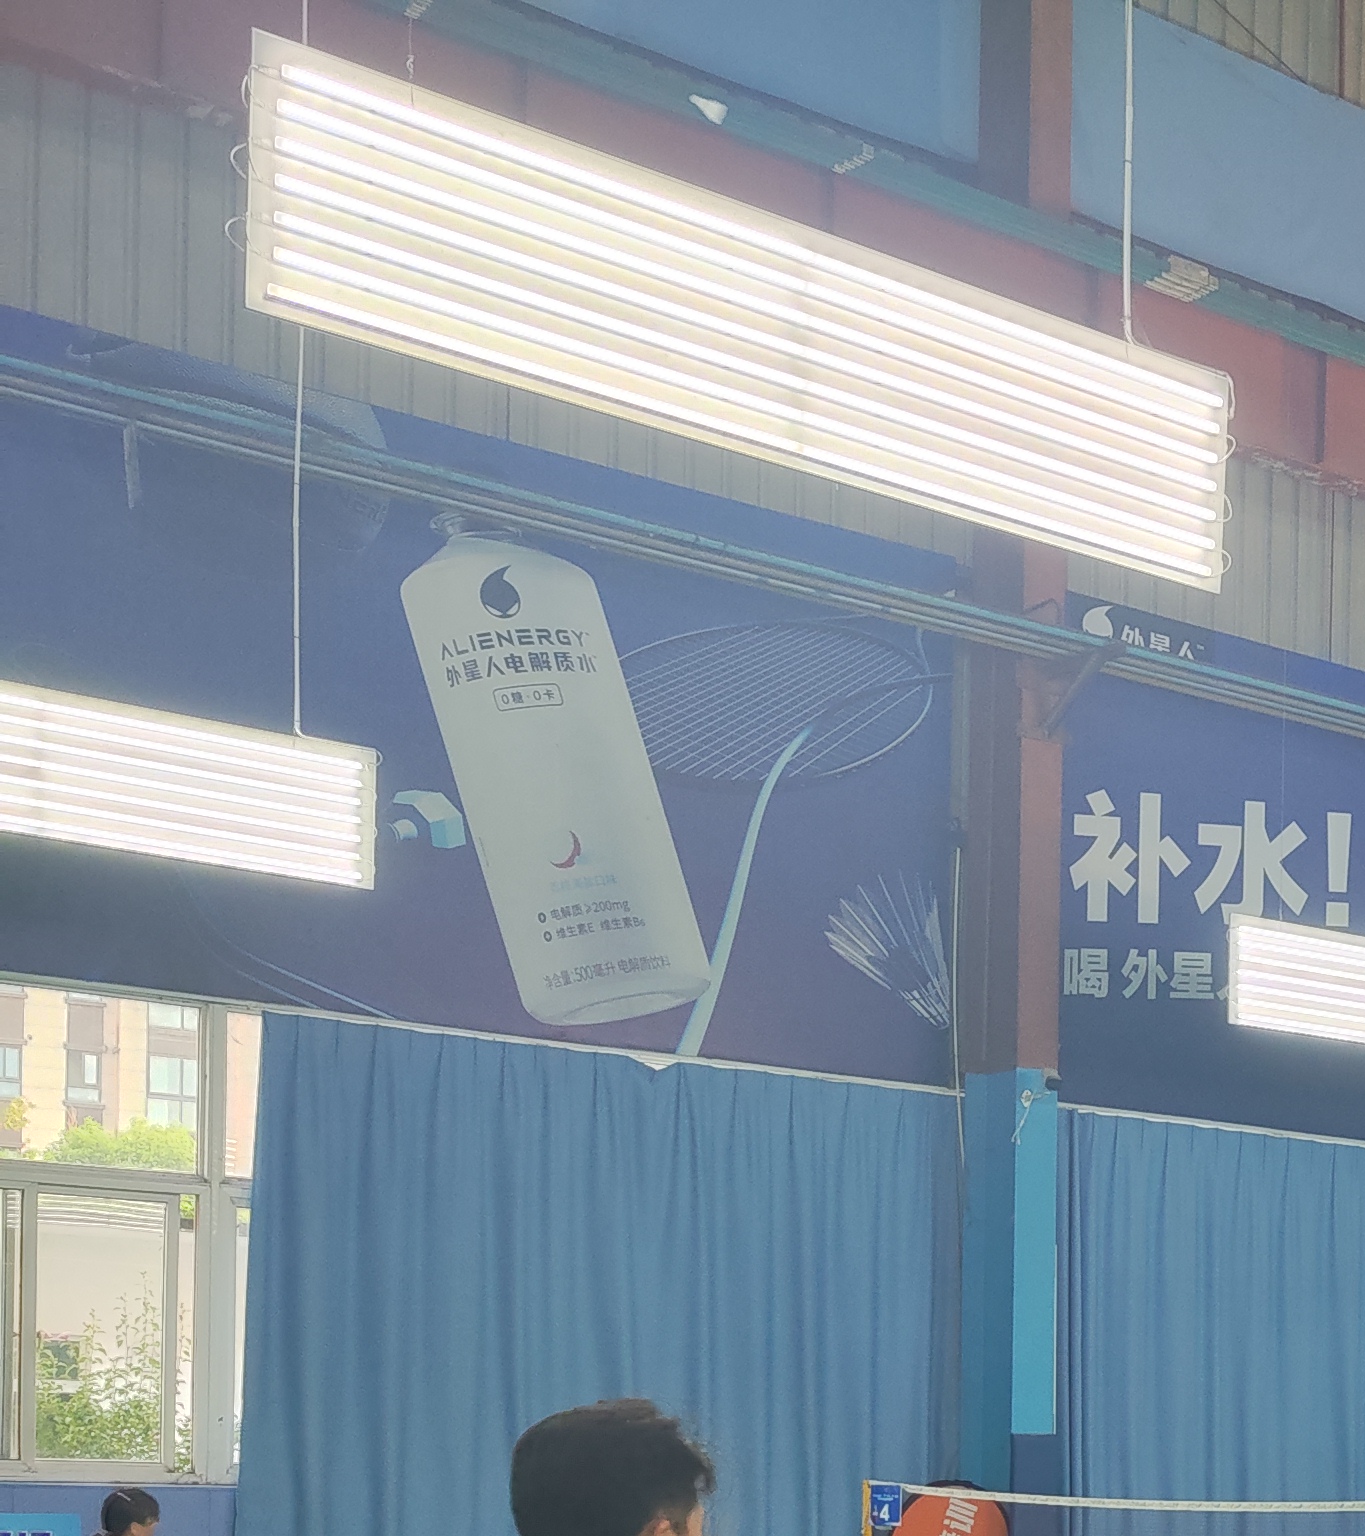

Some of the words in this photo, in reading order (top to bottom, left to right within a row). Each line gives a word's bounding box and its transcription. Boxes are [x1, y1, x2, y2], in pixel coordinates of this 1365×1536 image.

[441, 628, 585, 660] ALIENERGY
[445, 651, 597, 688] 外星人电解质水
[879, 1503, 890, 1521] 4
